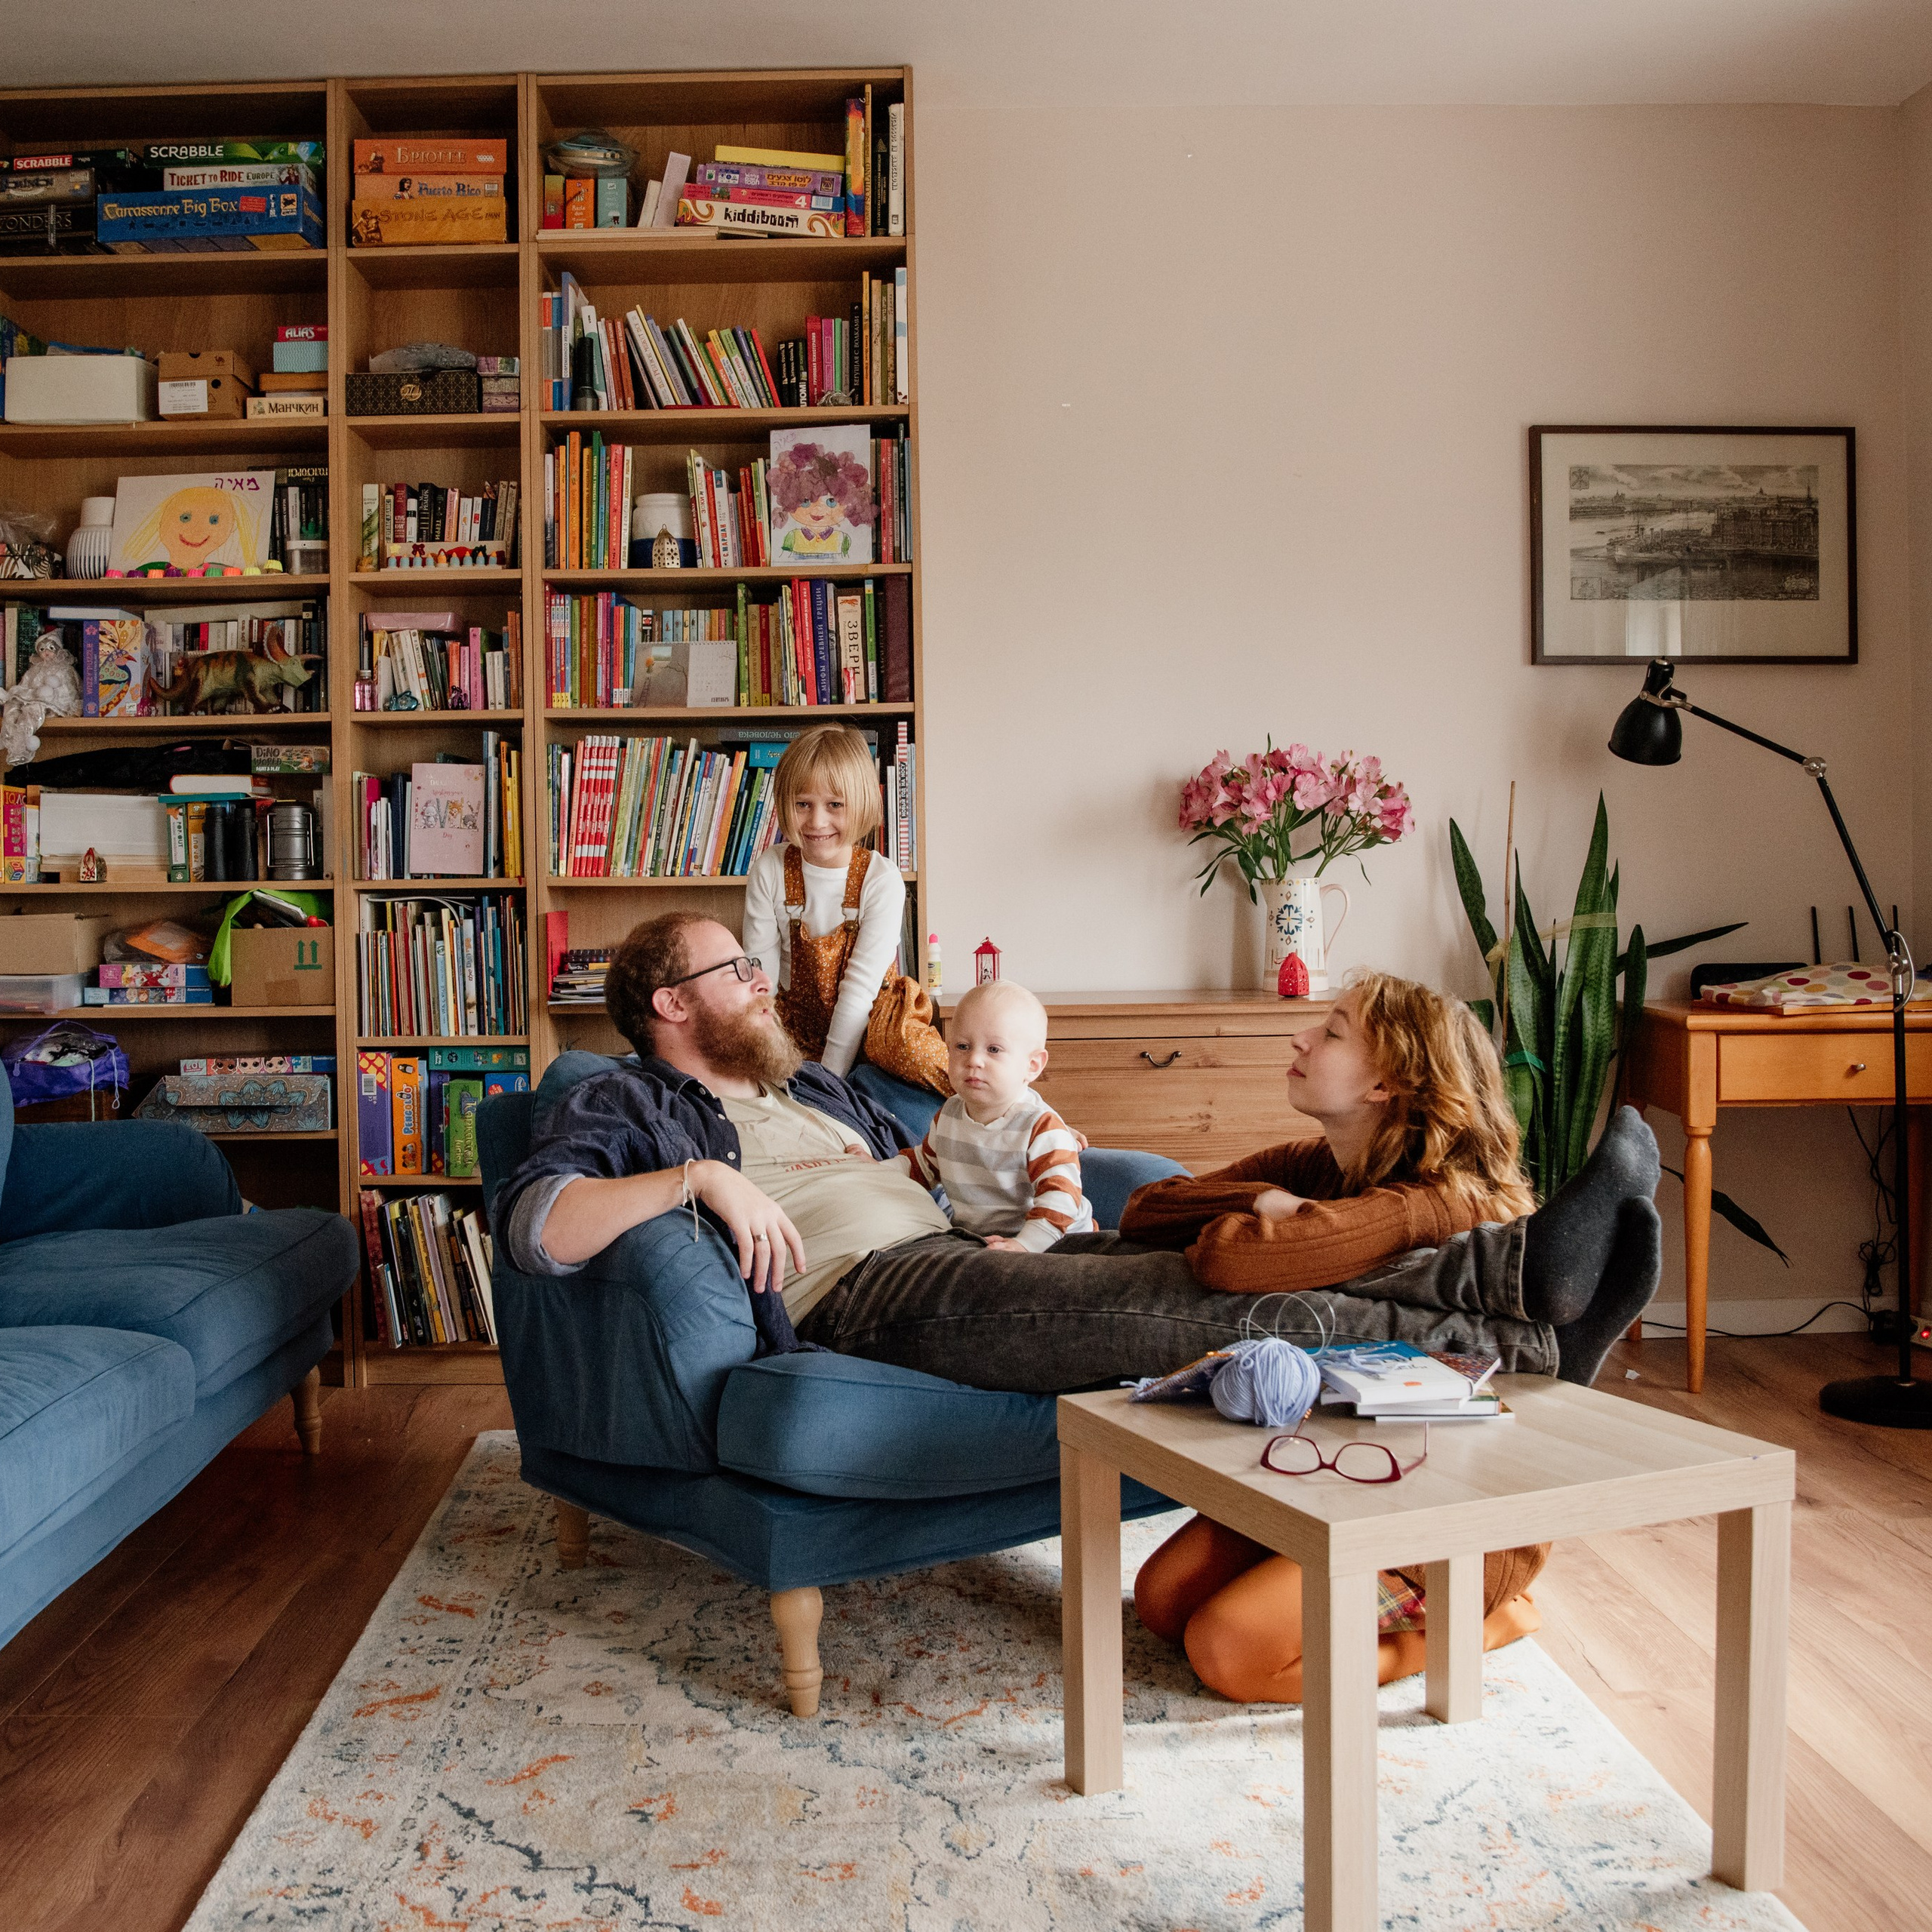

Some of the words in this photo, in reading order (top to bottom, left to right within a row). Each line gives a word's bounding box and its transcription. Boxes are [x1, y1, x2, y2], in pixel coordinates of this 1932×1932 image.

[150, 145, 224, 159] SCRABBLE
[16, 157, 72, 169] SCRABBLE
[220, 170, 245, 183] RIDE
[417, 182, 452, 196] Puerto
[455, 181, 481, 196] Rico
[182, 198, 207, 217] Big
[208, 197, 238, 214] Box
[795, 195, 807, 208] 4
[0, 213, 72, 229] ONDERS
[380, 208, 438, 223] STONE
[442, 208, 484, 222] AGE
[814, 587, 824, 620] ГРЕЦИИ
[816, 624, 826, 661] ДРЕВНЕЙ
[173, 967, 179, 976] 4
